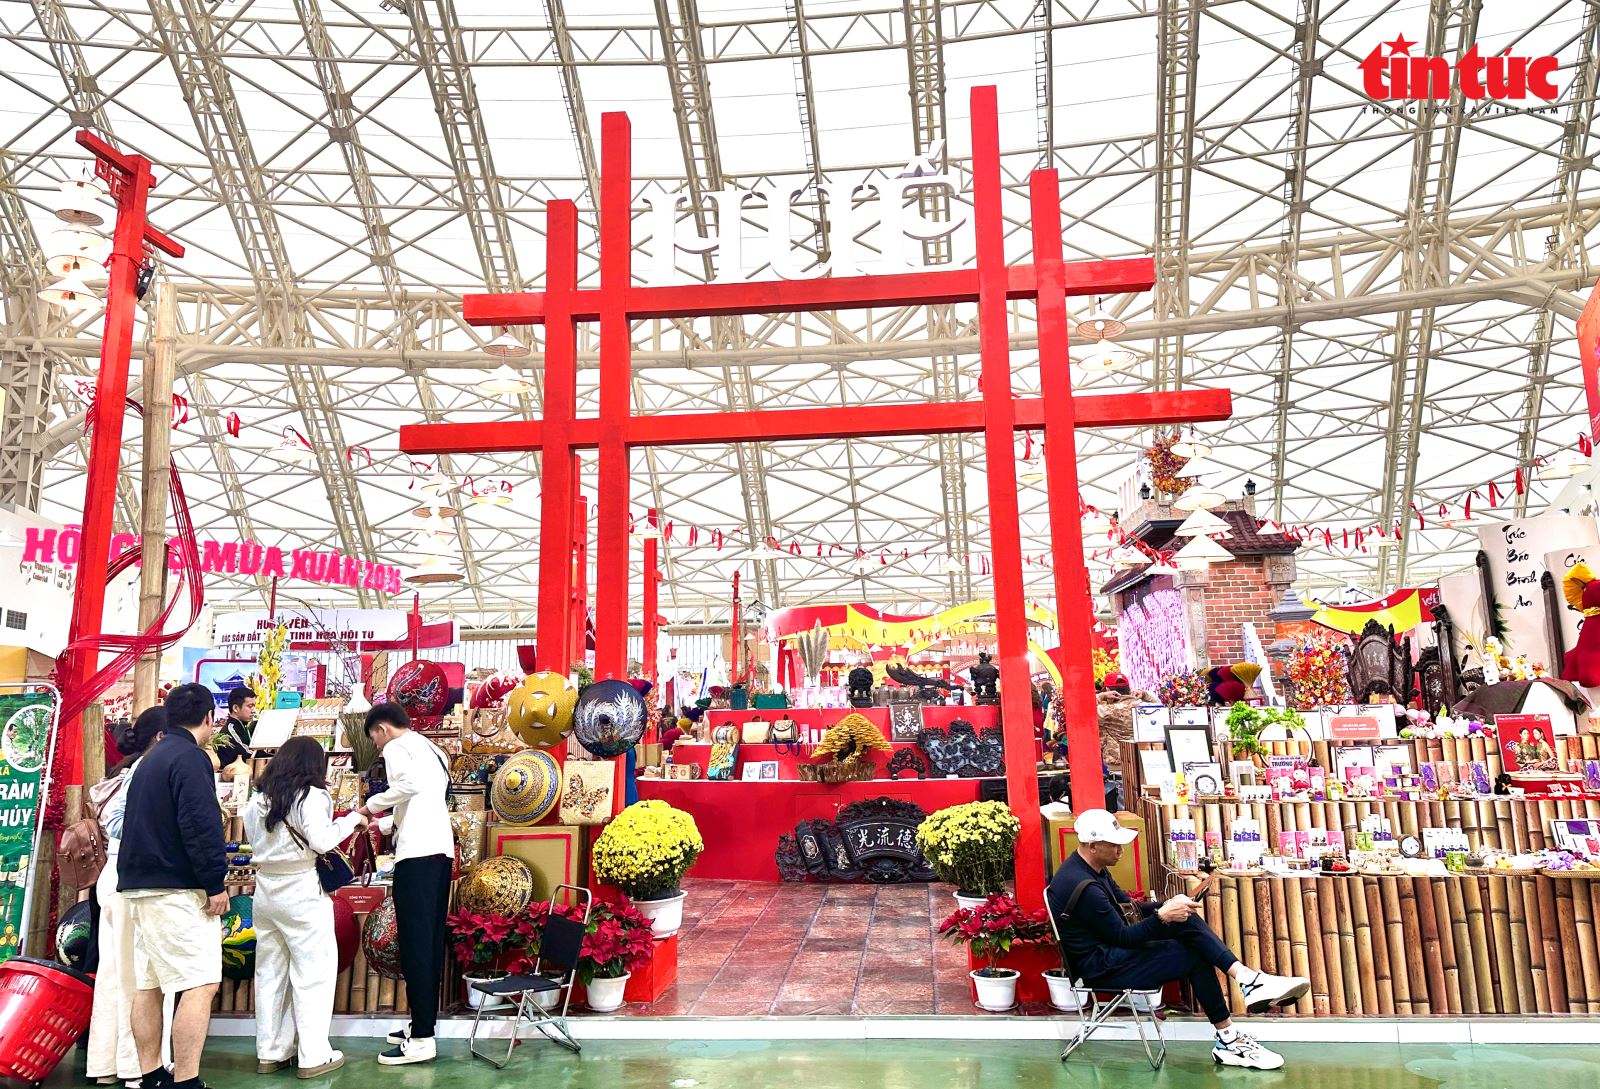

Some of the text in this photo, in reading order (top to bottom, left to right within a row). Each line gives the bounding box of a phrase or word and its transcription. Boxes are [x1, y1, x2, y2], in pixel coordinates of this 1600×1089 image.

[23, 525, 81, 569] HỘ
[202, 538, 285, 577] MÙA
[290, 549, 361, 588] XUÂN
[232, 631, 246, 642] SẢN
[247, 630, 262, 642] ĐẤT
[290, 631, 313, 640] TINH
[341, 629, 359, 640] HỘI
[362, 630, 375, 641] TỤ
